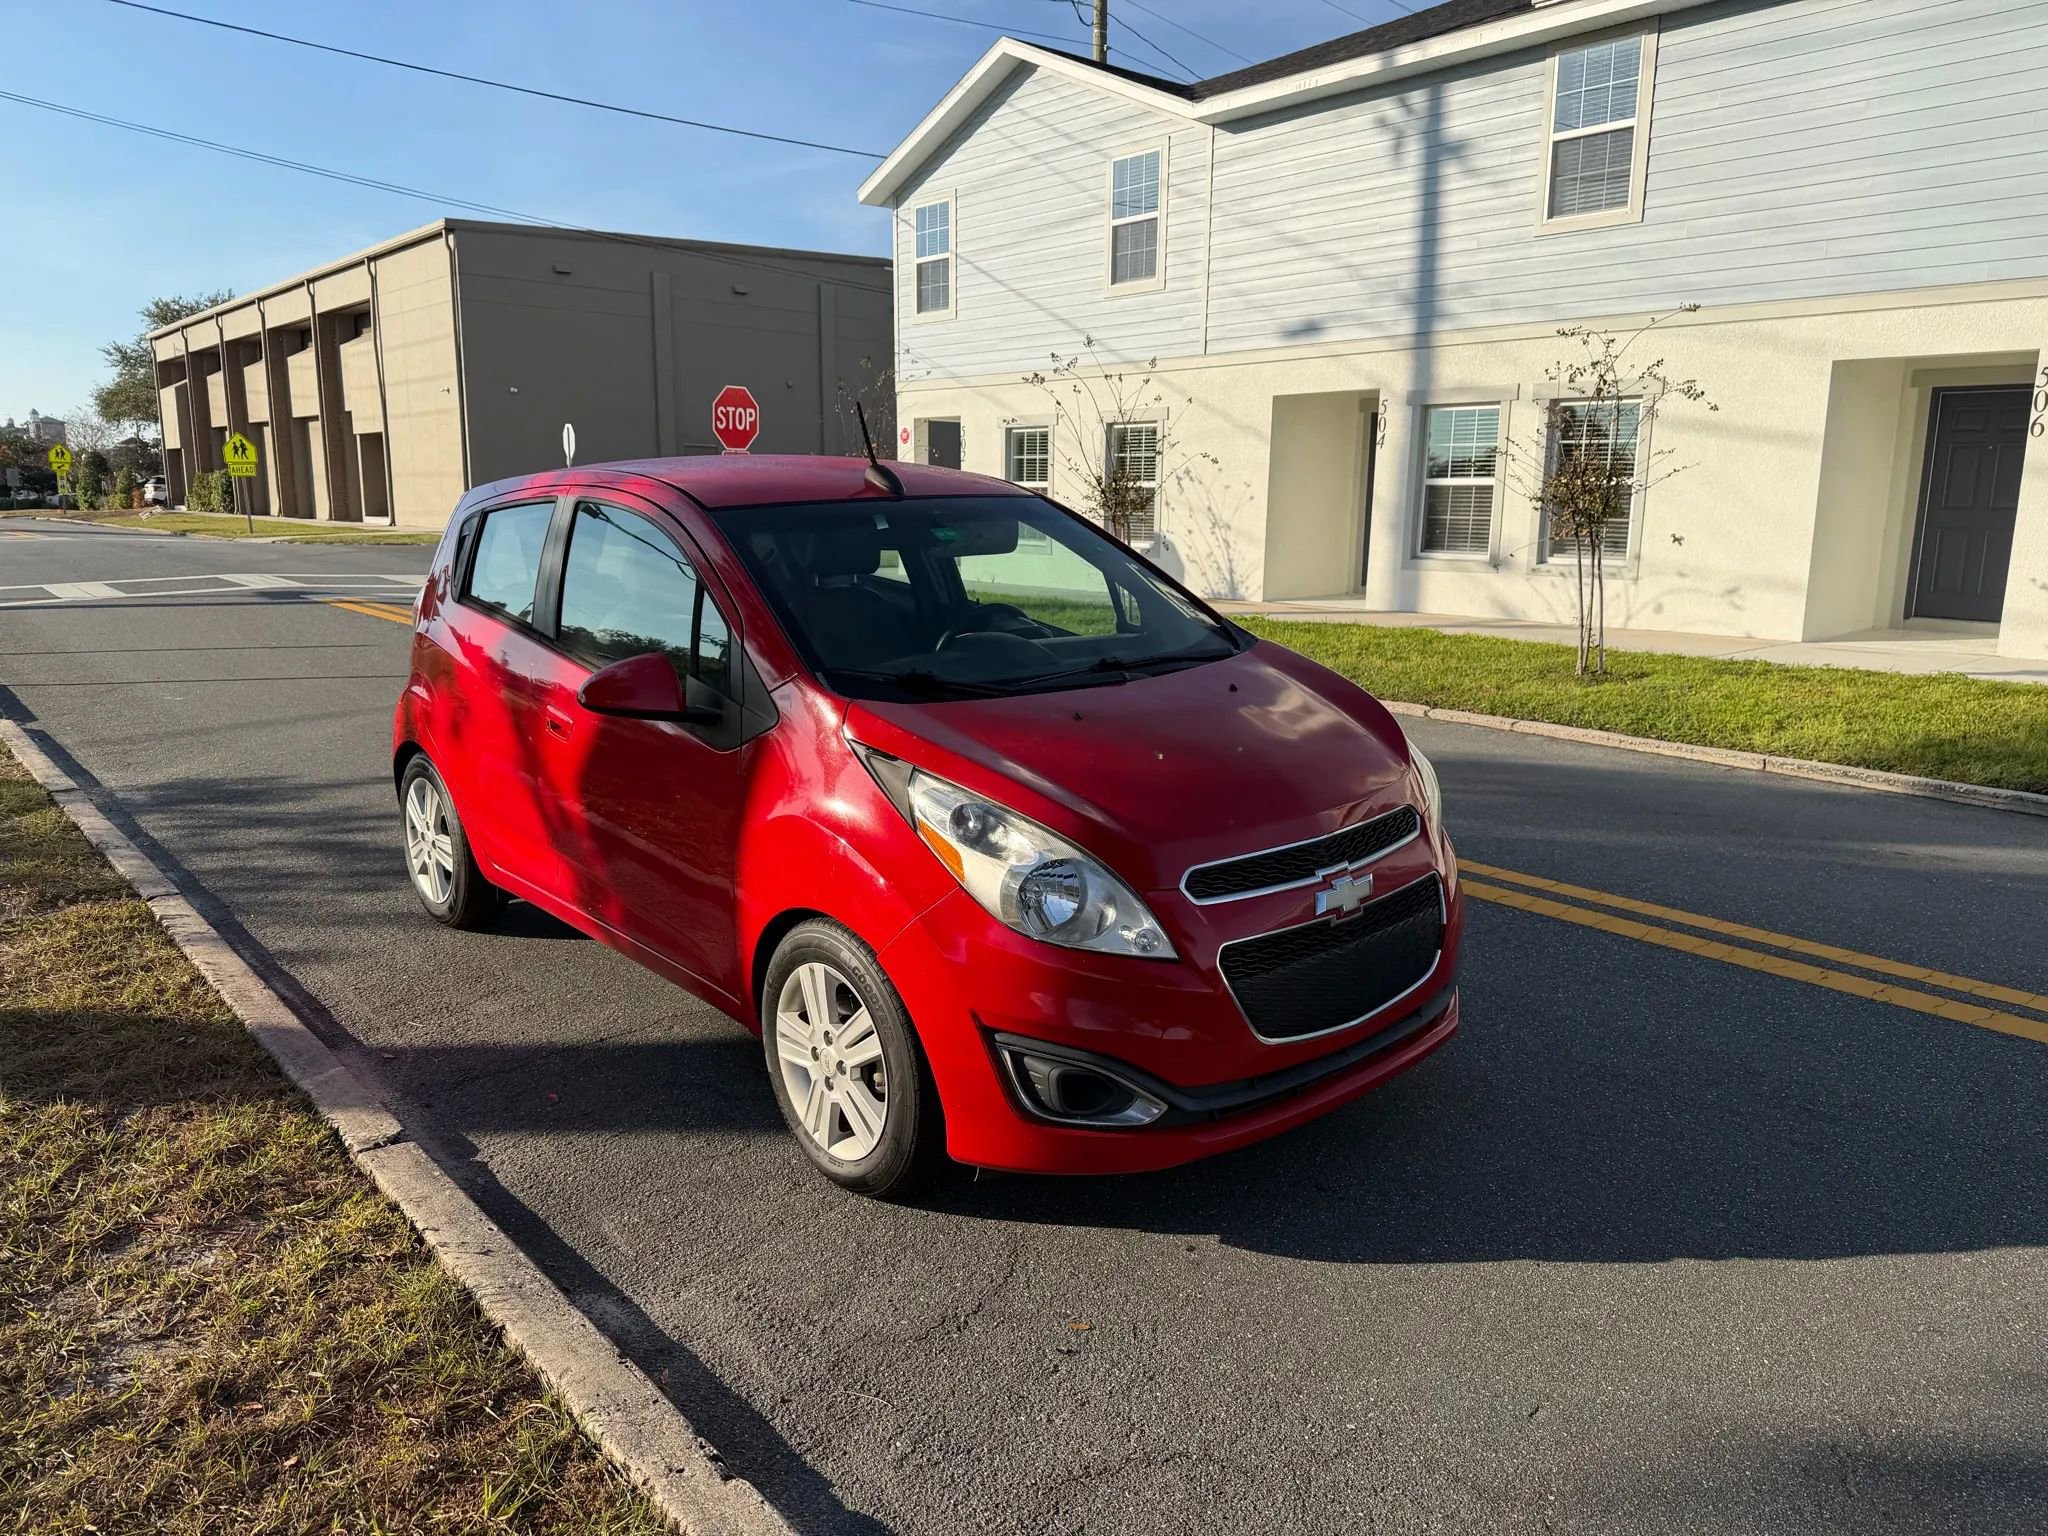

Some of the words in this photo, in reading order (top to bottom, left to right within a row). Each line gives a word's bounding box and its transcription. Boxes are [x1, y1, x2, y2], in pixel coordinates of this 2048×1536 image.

[717, 406, 756, 431] STOP
[2030, 366, 2048, 438] 506
[1376, 399, 1388, 449] 504
[231, 465, 254, 474] AHEAD
